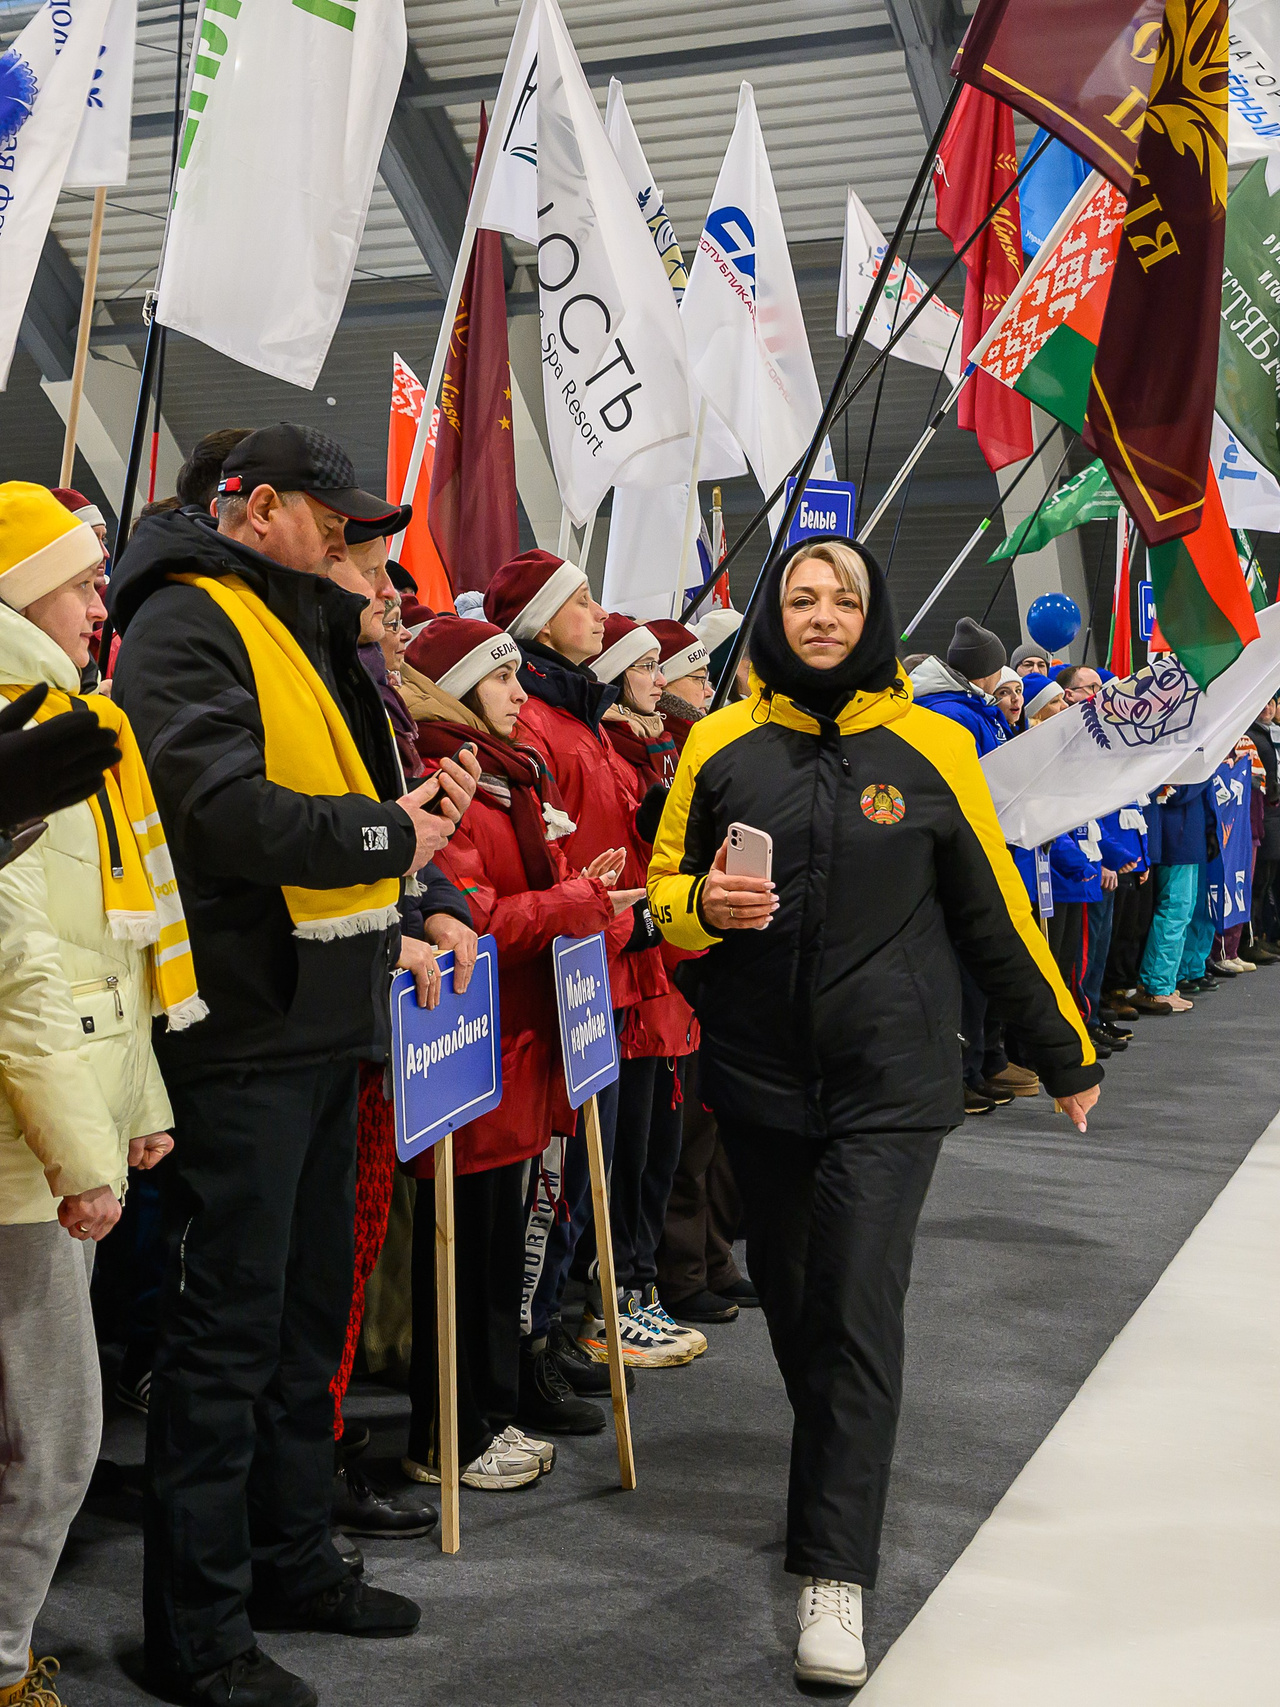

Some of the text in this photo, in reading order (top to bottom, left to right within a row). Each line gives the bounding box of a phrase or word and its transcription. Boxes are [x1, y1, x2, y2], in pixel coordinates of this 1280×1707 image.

[538, 202, 643, 432] ОСТЬ
[541, 332, 605, 457] Spa Resort
[799, 501, 837, 531] Белые
[565, 968, 596, 1012] Моднае
[406, 1013, 489, 1080] Агрохолдинг
[570, 1006, 607, 1060] народнае
